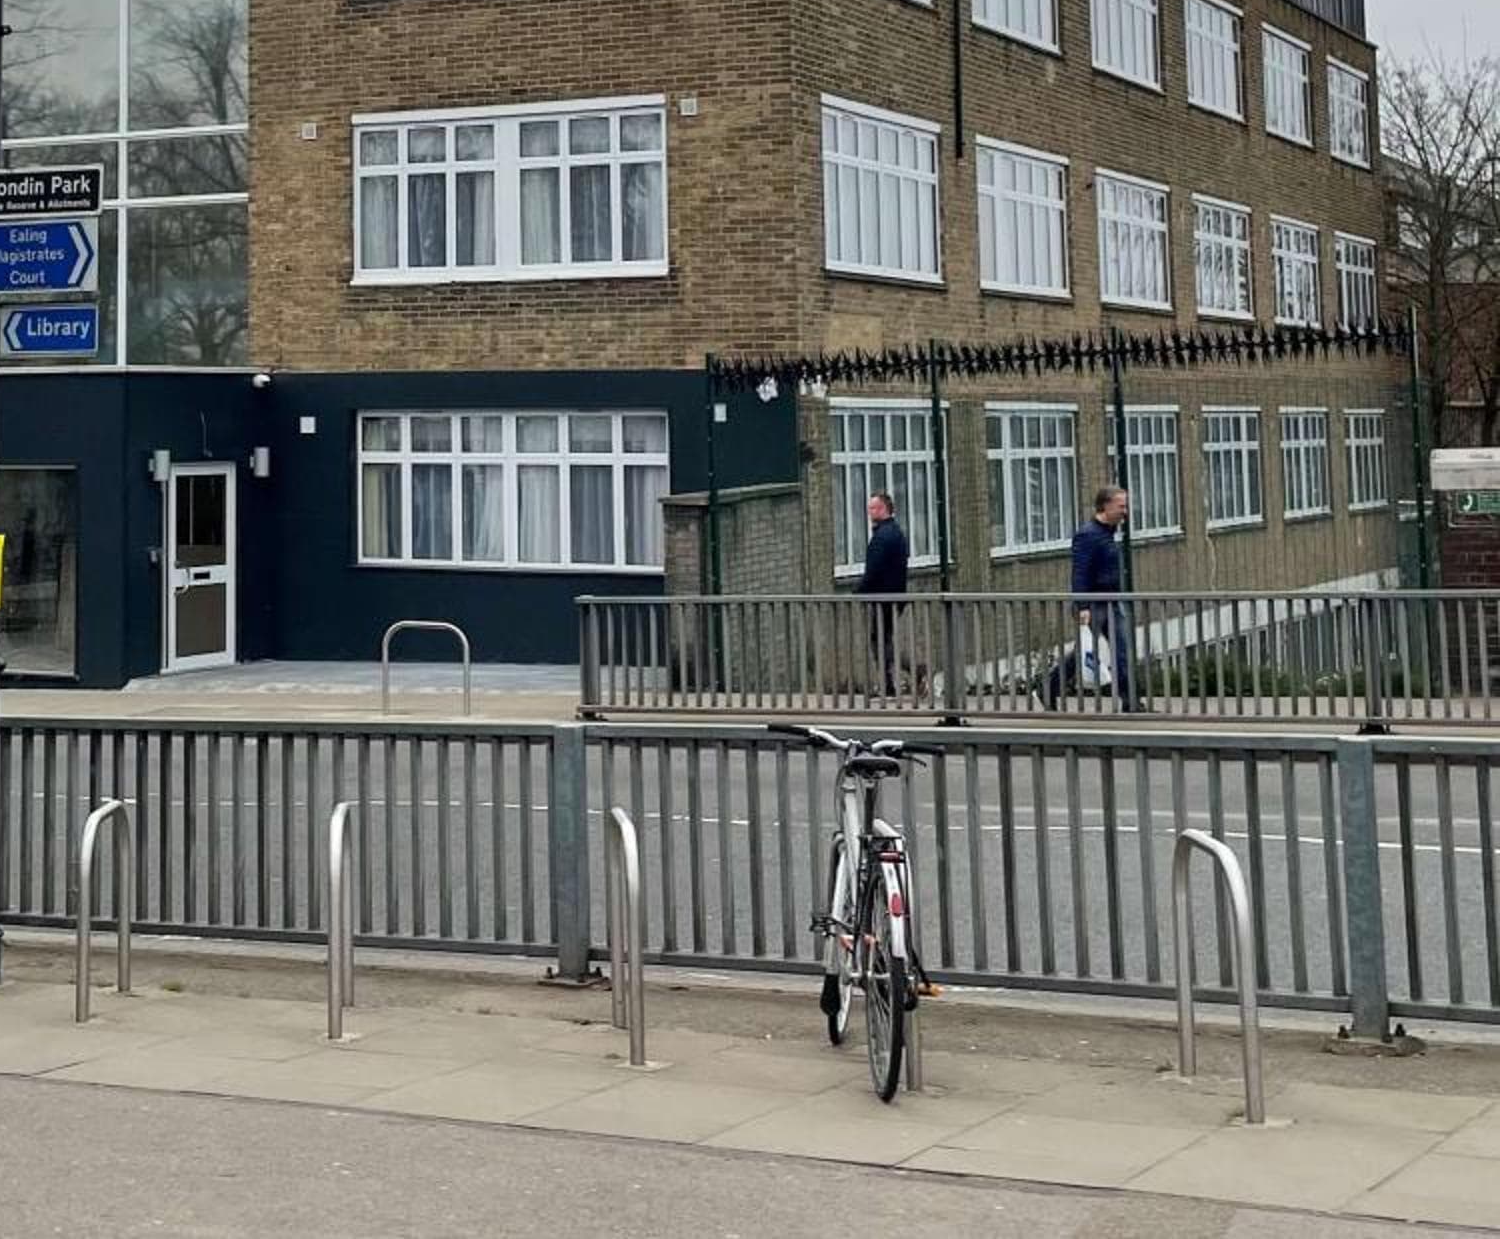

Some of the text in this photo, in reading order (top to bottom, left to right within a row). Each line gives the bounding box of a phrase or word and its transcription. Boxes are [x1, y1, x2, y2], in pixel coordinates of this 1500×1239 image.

[51, 174, 91, 194] Park
[9, 228, 48, 244] Ealing
[9, 270, 46, 285] Court
[27, 317, 90, 339] Library
